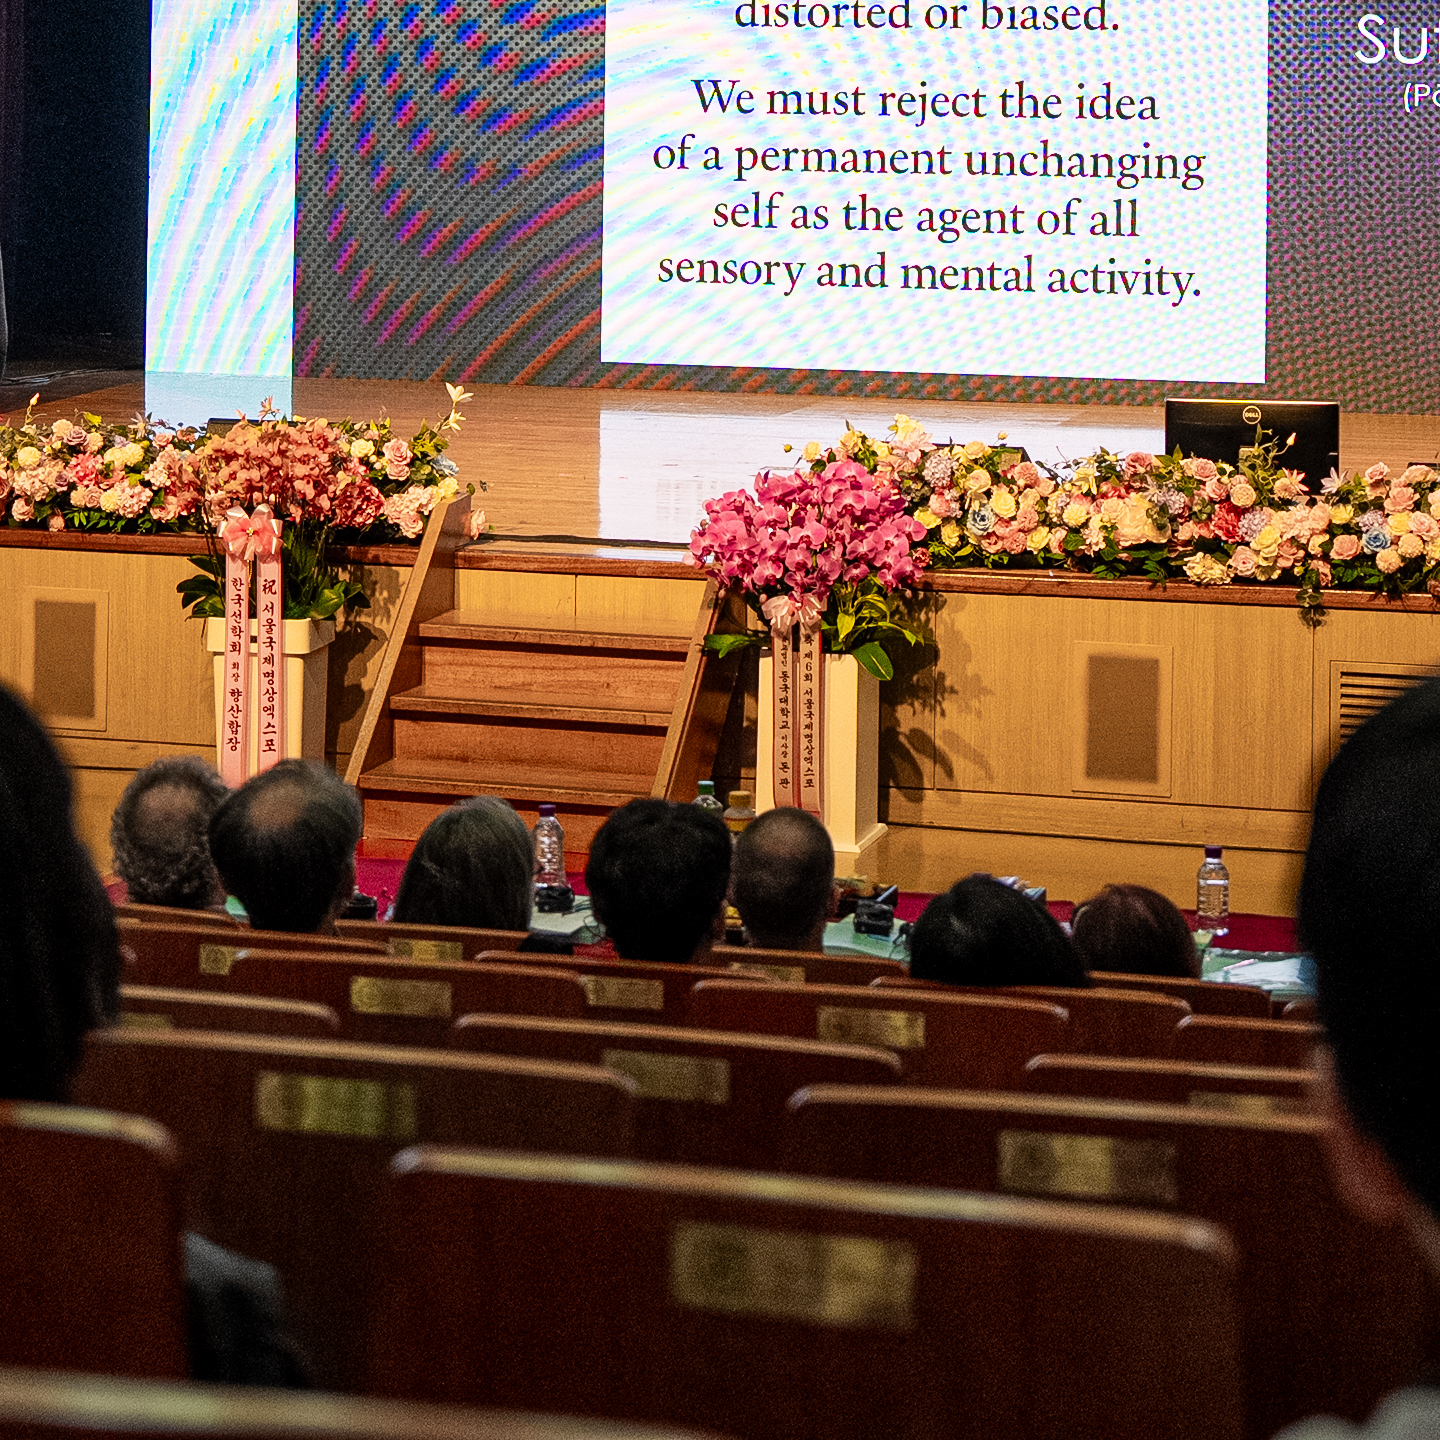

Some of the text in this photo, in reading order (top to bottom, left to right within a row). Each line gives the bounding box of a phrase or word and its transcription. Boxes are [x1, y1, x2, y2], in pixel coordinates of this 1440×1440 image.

[924, 3, 967, 30] or
[690, 79, 1161, 127] We must reject the idea
[652, 134, 1207, 191] of a permanent unchanging
[712, 191, 1140, 244] self as the agent of all
[658, 252, 1201, 307] sensory and mental activity.
[231, 662, 241, 683] 회장
[262, 578, 277, 753] 祝 서울국제명상엑스포
[803, 650, 812, 683] 제6회
[779, 671, 790, 729] 동국대학교
[803, 688, 815, 788] 서울국제명상엑스포
